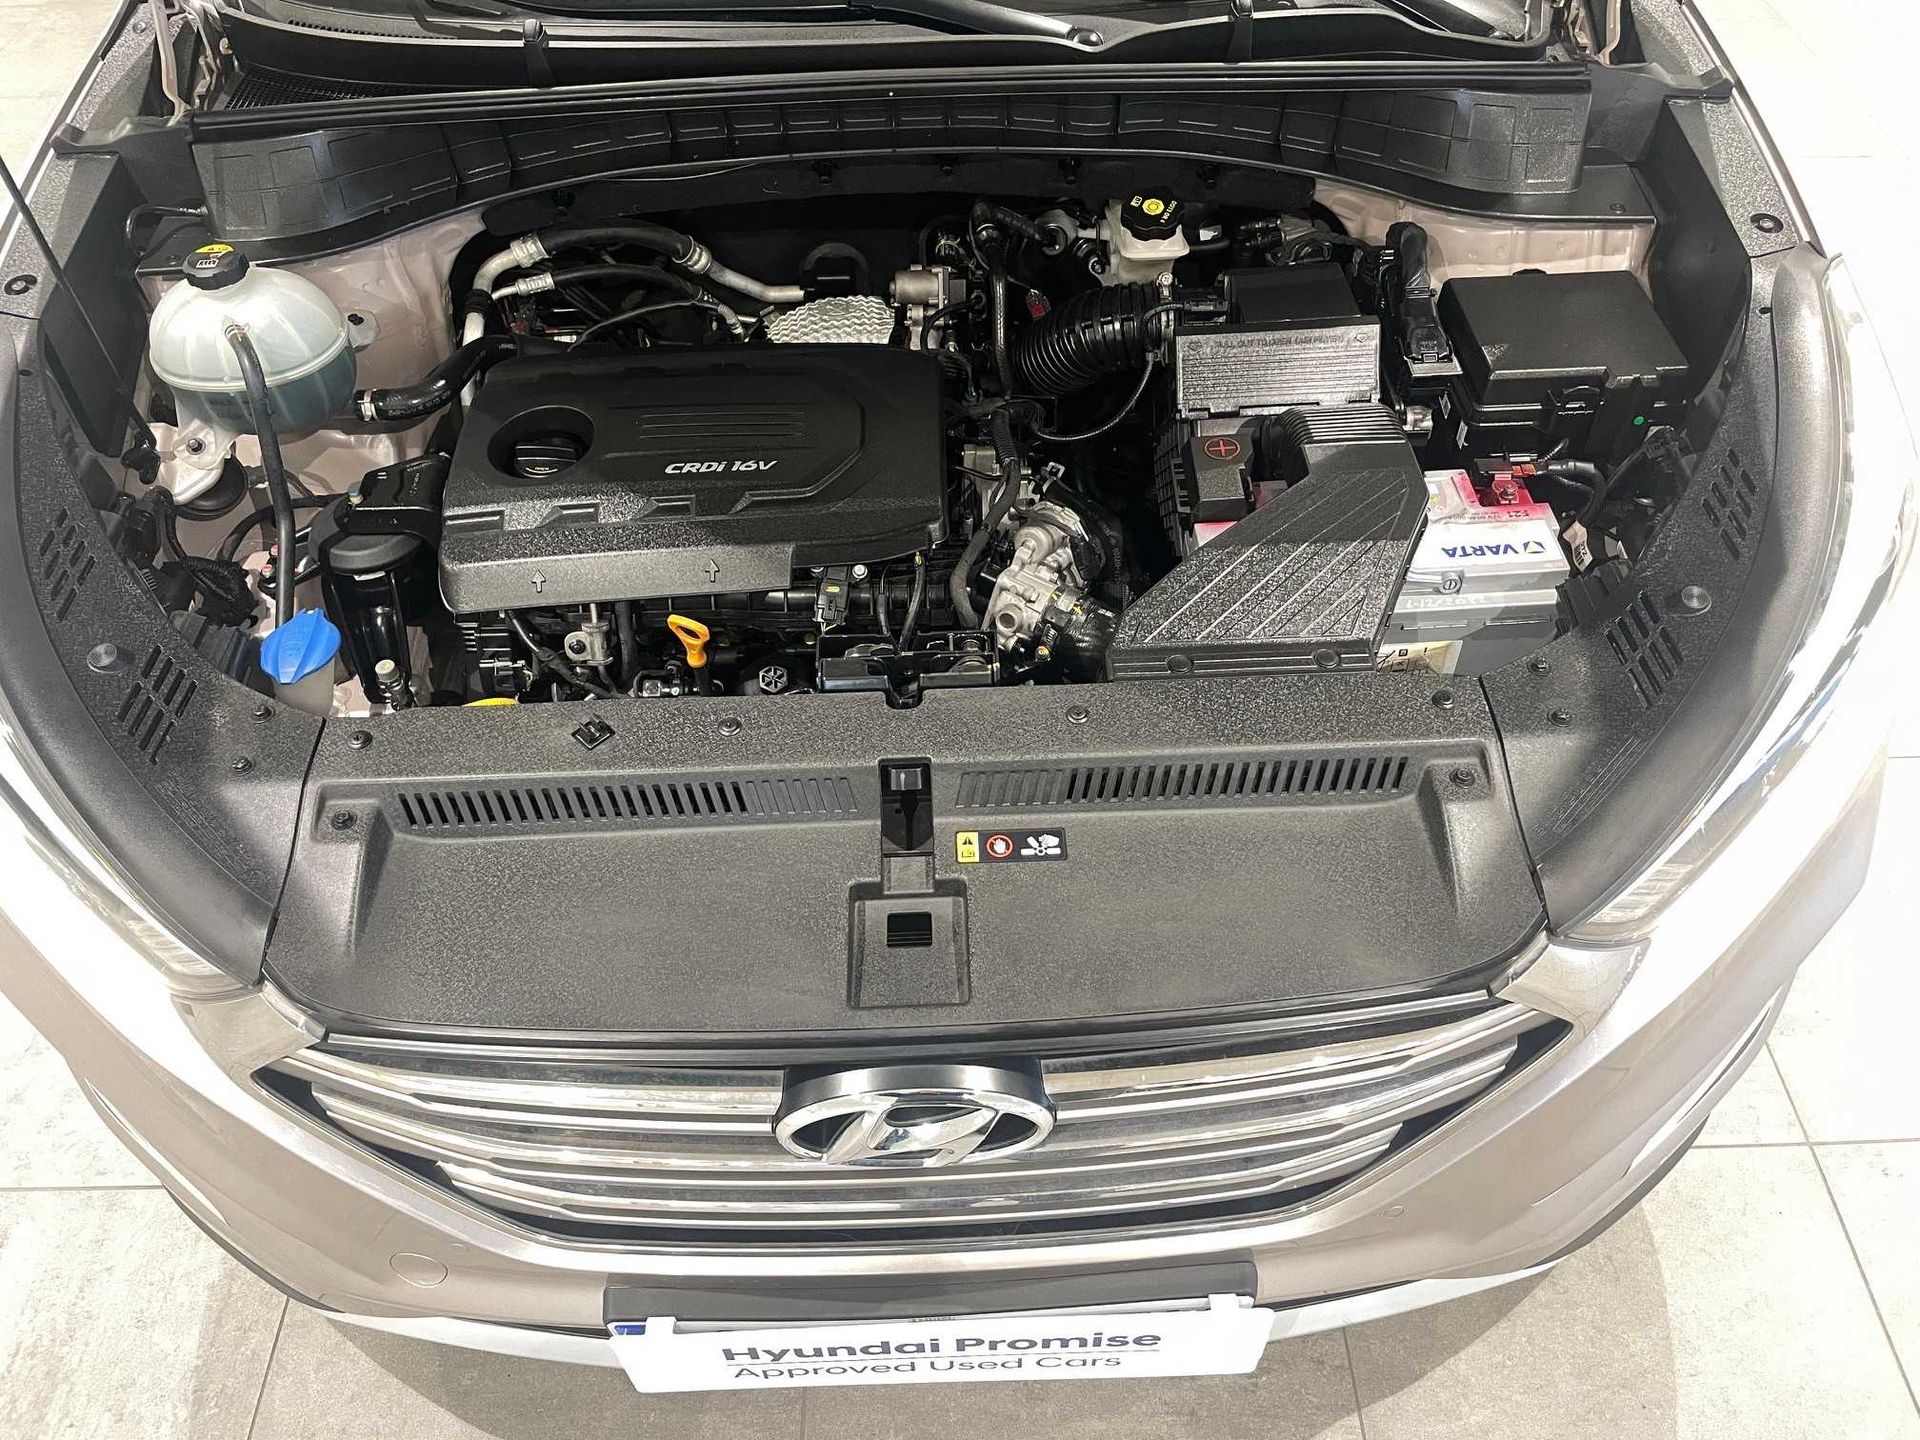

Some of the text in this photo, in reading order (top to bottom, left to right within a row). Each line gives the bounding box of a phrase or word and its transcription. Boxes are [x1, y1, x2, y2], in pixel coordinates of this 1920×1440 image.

[664, 459, 778, 474] CRDi 16V
[1441, 543, 1520, 558] VARTA
[722, 1332, 1162, 1363] Hyundai Promise
[734, 1354, 1121, 1379] Approved Used Cars
